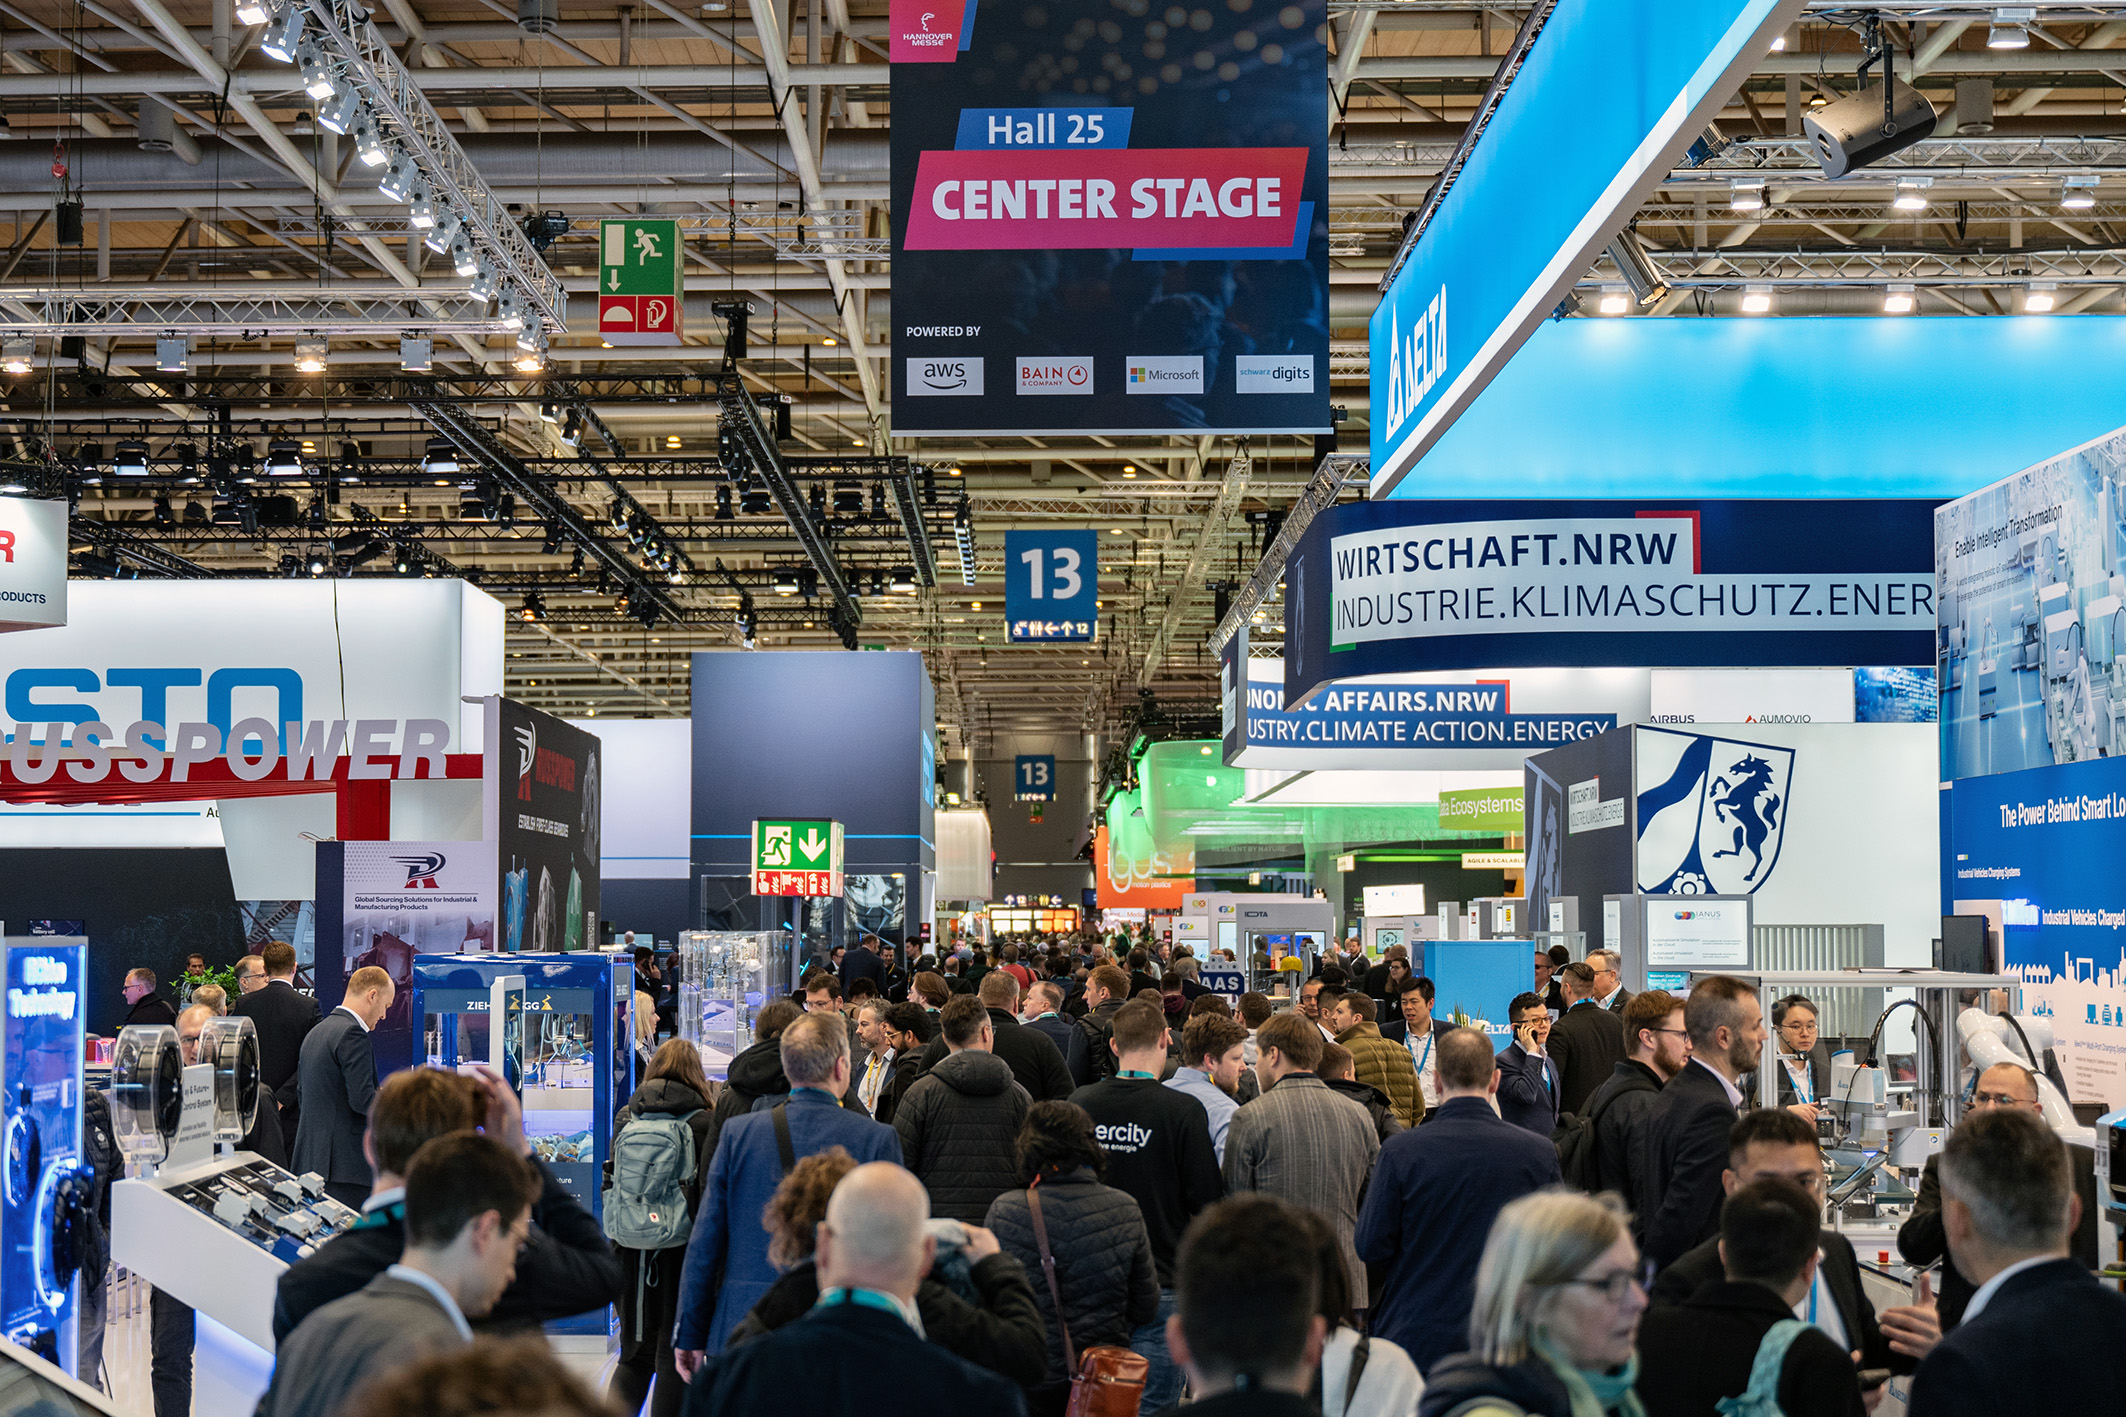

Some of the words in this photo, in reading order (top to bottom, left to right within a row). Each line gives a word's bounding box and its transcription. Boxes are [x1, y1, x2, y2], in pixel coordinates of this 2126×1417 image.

[988, 113, 1055, 144] Hall
[1066, 114, 1105, 143] 25
[932, 179, 1118, 220] CENTER
[1130, 177, 1281, 219] STAGE
[906, 327, 964, 337] POWERED
[966, 326, 981, 336] BY
[1405, 283, 1448, 420] DELTA
[924, 362, 966, 378] aws
[1022, 367, 1063, 379] BAIN
[1149, 369, 1200, 381] Microsoft
[1240, 368, 1271, 376] schwarz
[1272, 366, 1310, 382] digits
[1955, 536, 1976, 558] Enable
[1976, 523, 2009, 551] Intelligent
[2009, 504, 2063, 538] Transformation
[1337, 533, 1677, 580] WIRTSCHAFT.NRW
[1021, 547, 1082, 599] 13
[0, 592, 46, 604] ODUCTS
[1337, 584, 1935, 631] INDUSTRIE.KLIMASCHUTZ.ENER
[1076, 623, 1089, 634] 12
[1325, 691, 1498, 712] AFFAIRS.NRW
[1651, 714, 1695, 724] AIRBUS
[1759, 714, 1811, 724] AUMOVIO
[1413, 721, 1609, 742] ACTION.ENERGY
[0, 717, 451, 784] USSPOWER
[1021, 762, 1049, 786] 13
[1450, 796, 1524, 818] Ecosystems
[2000, 804, 2017, 828] The
[2018, 802, 2047, 826] Power
[2047, 796, 2080, 824] Behind
[2081, 793, 2111, 821] Smart
[1957, 868, 1974, 879] Industrial
[1973, 867, 1988, 878] Vehicles
[1988, 866, 2005, 880] Charging
[2004, 866, 2021, 880] Systems
[1150, 881, 1172, 889] plastics
[375, 896, 404, 905] Sourcing
[1016, 895, 1027, 904] 12
[1696, 910, 1721, 918] IANUS
[2042, 909, 2070, 925] Industrial
[2070, 909, 2097, 926] Vehicles
[2097, 908, 2126, 930] Charged
[1095, 1122, 1152, 1147] ercity
[1111, 1143, 1137, 1153] energie
